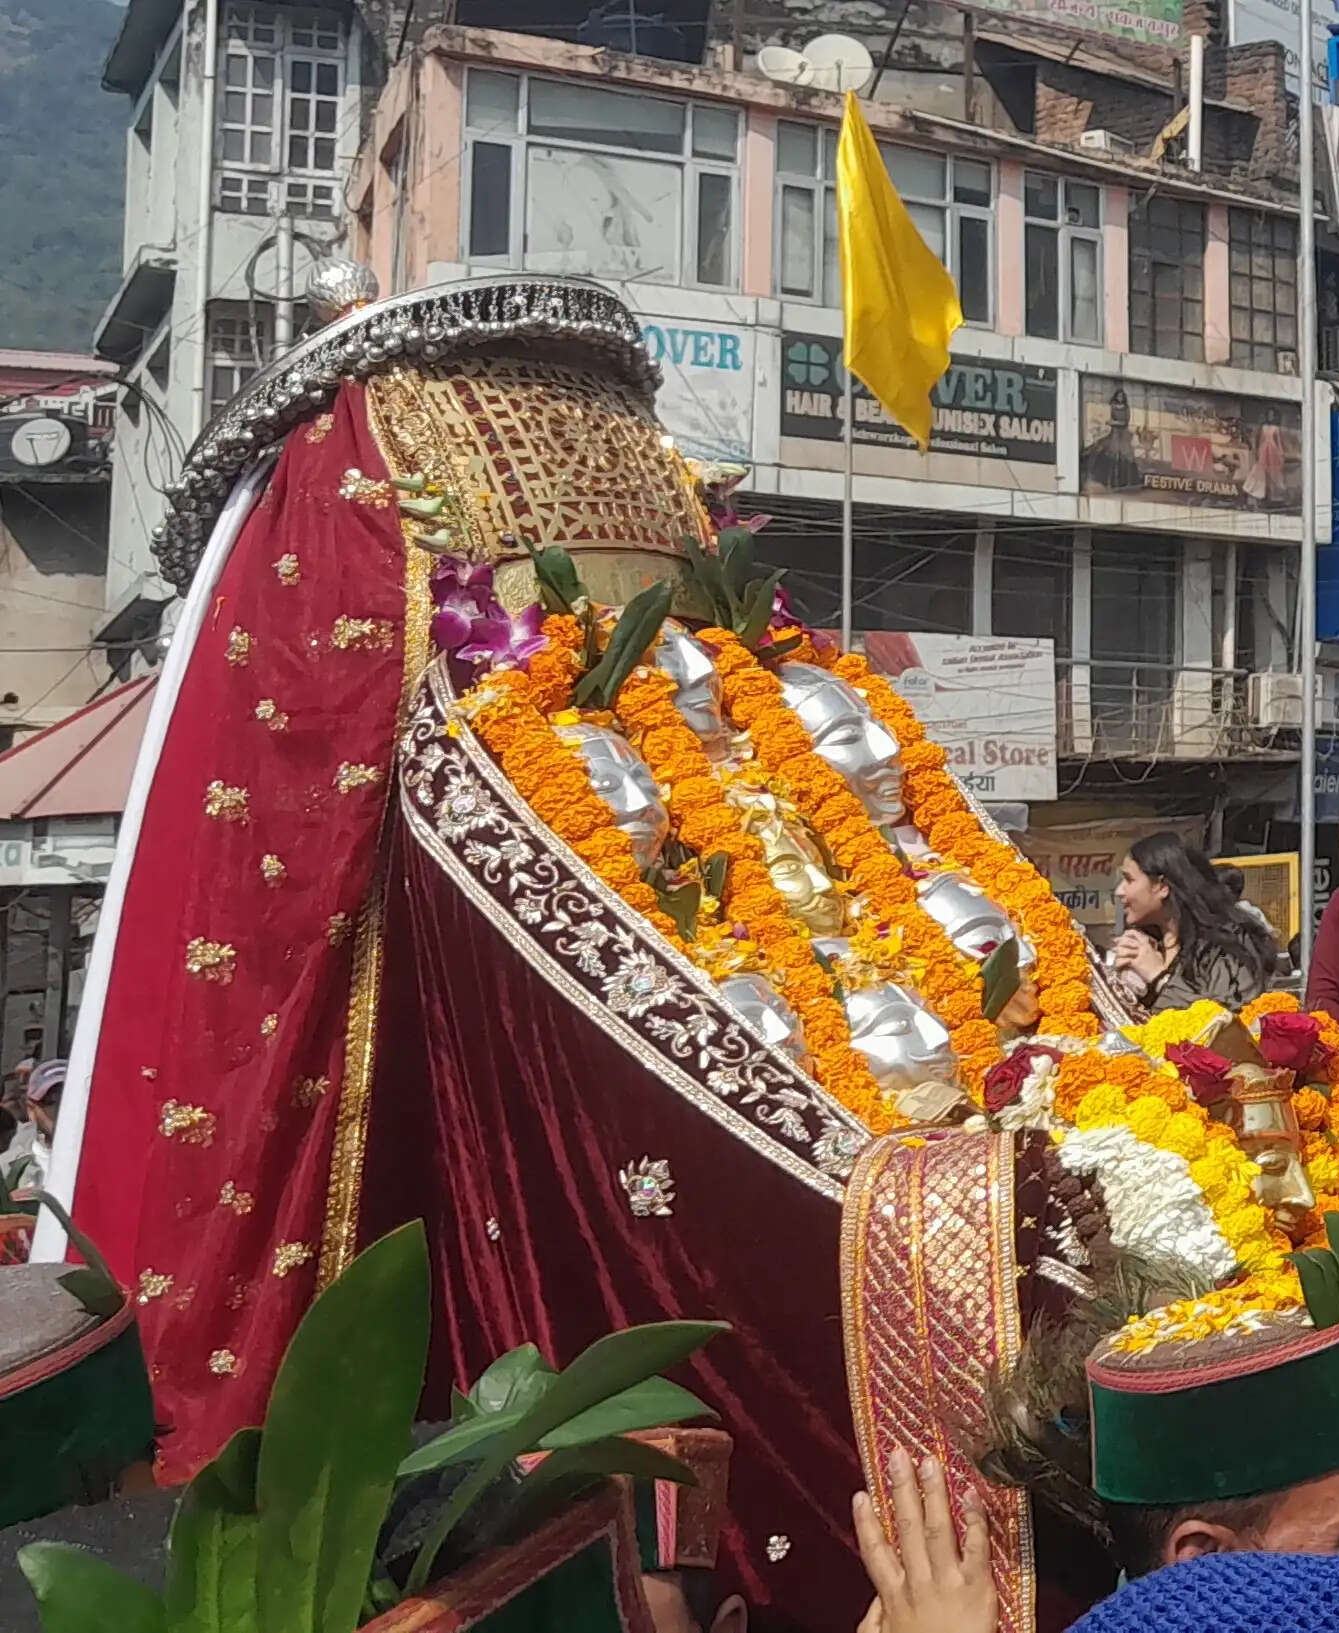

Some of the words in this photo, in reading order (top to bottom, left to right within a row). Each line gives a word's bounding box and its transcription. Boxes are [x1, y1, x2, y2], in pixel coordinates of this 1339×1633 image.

[785, 389, 833, 418] HAIR
[998, 415, 1055, 444] SALON
[1183, 445, 1207, 471] W
[1143, 474, 1193, 491] FESTIVE
[1196, 479, 1238, 497] DRAMA
[982, 739, 1049, 767] Store
